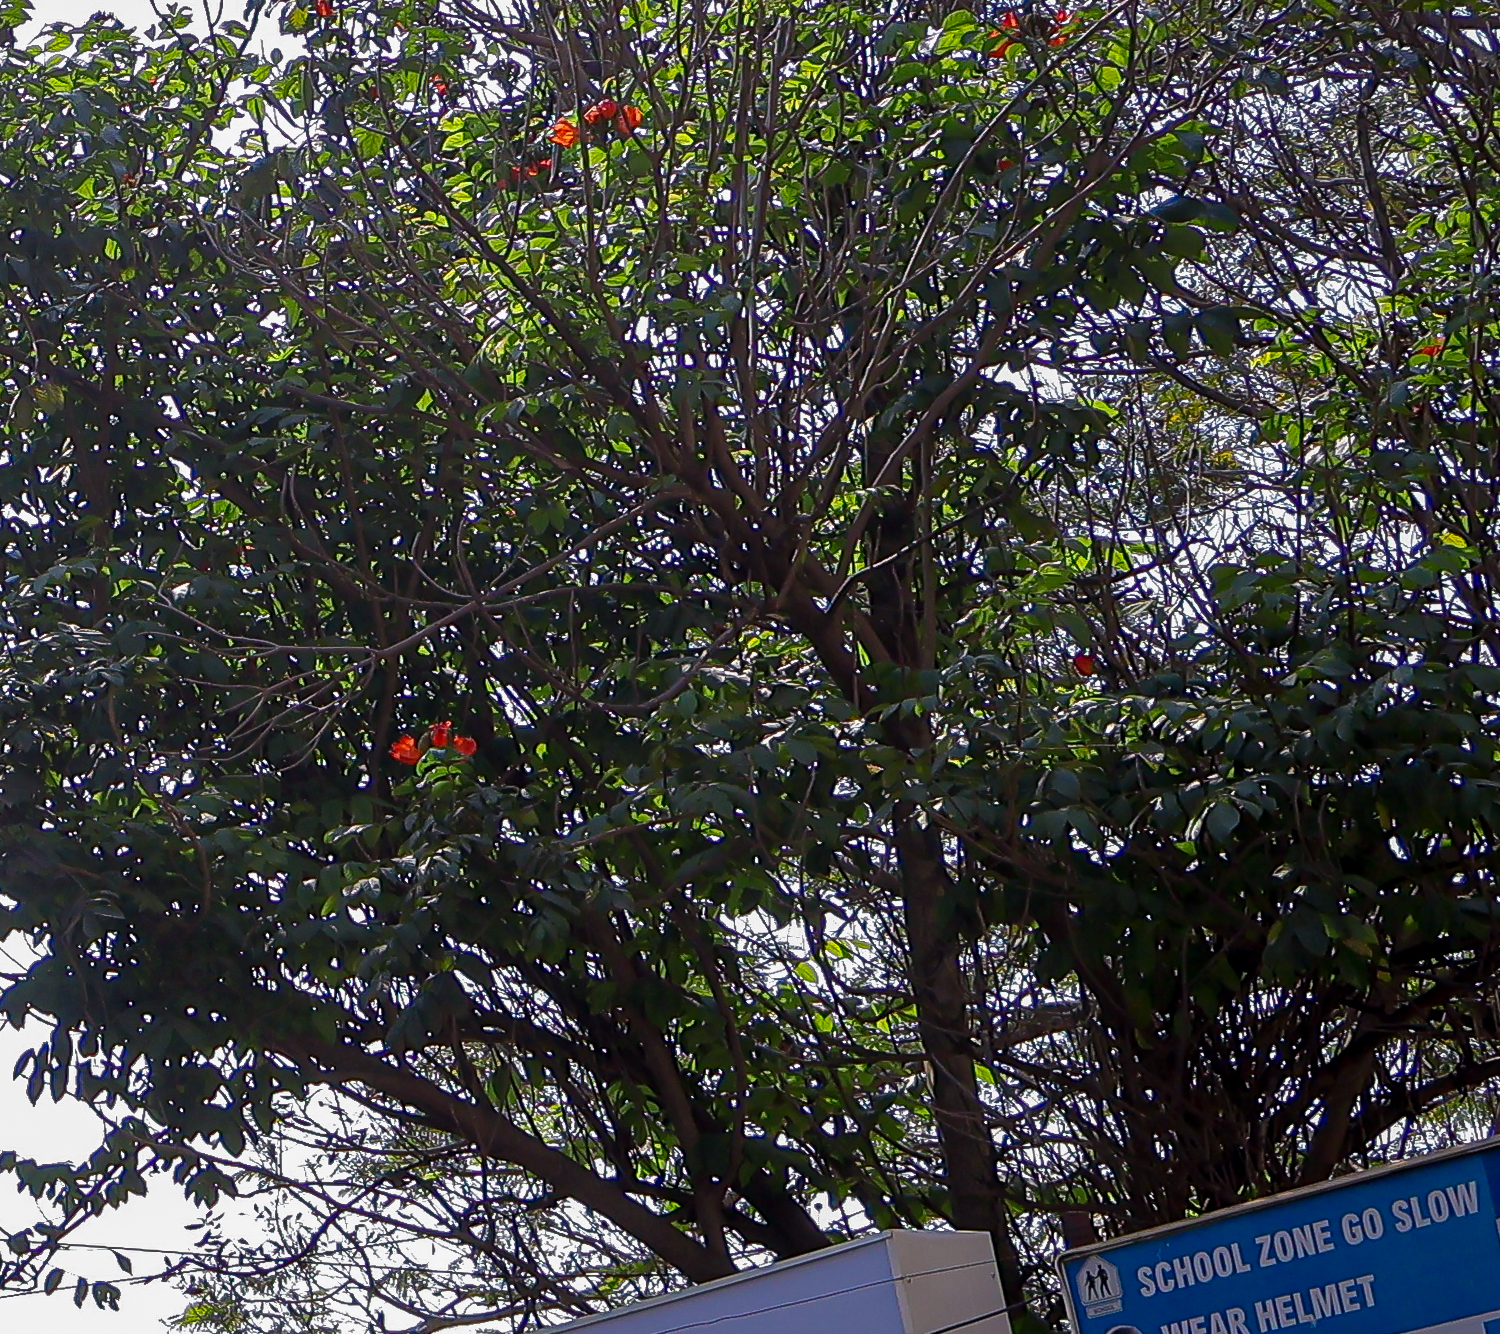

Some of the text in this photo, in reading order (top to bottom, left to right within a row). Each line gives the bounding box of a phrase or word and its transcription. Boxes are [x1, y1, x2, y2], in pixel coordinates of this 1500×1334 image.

[1136, 1242, 1252, 1298] SCHOOL
[1254, 1218, 1335, 1268] ZONE
[1341, 1207, 1385, 1246] GO
[1391, 1180, 1479, 1234] SLOW
[1254, 1274, 1376, 1334] HELMET
